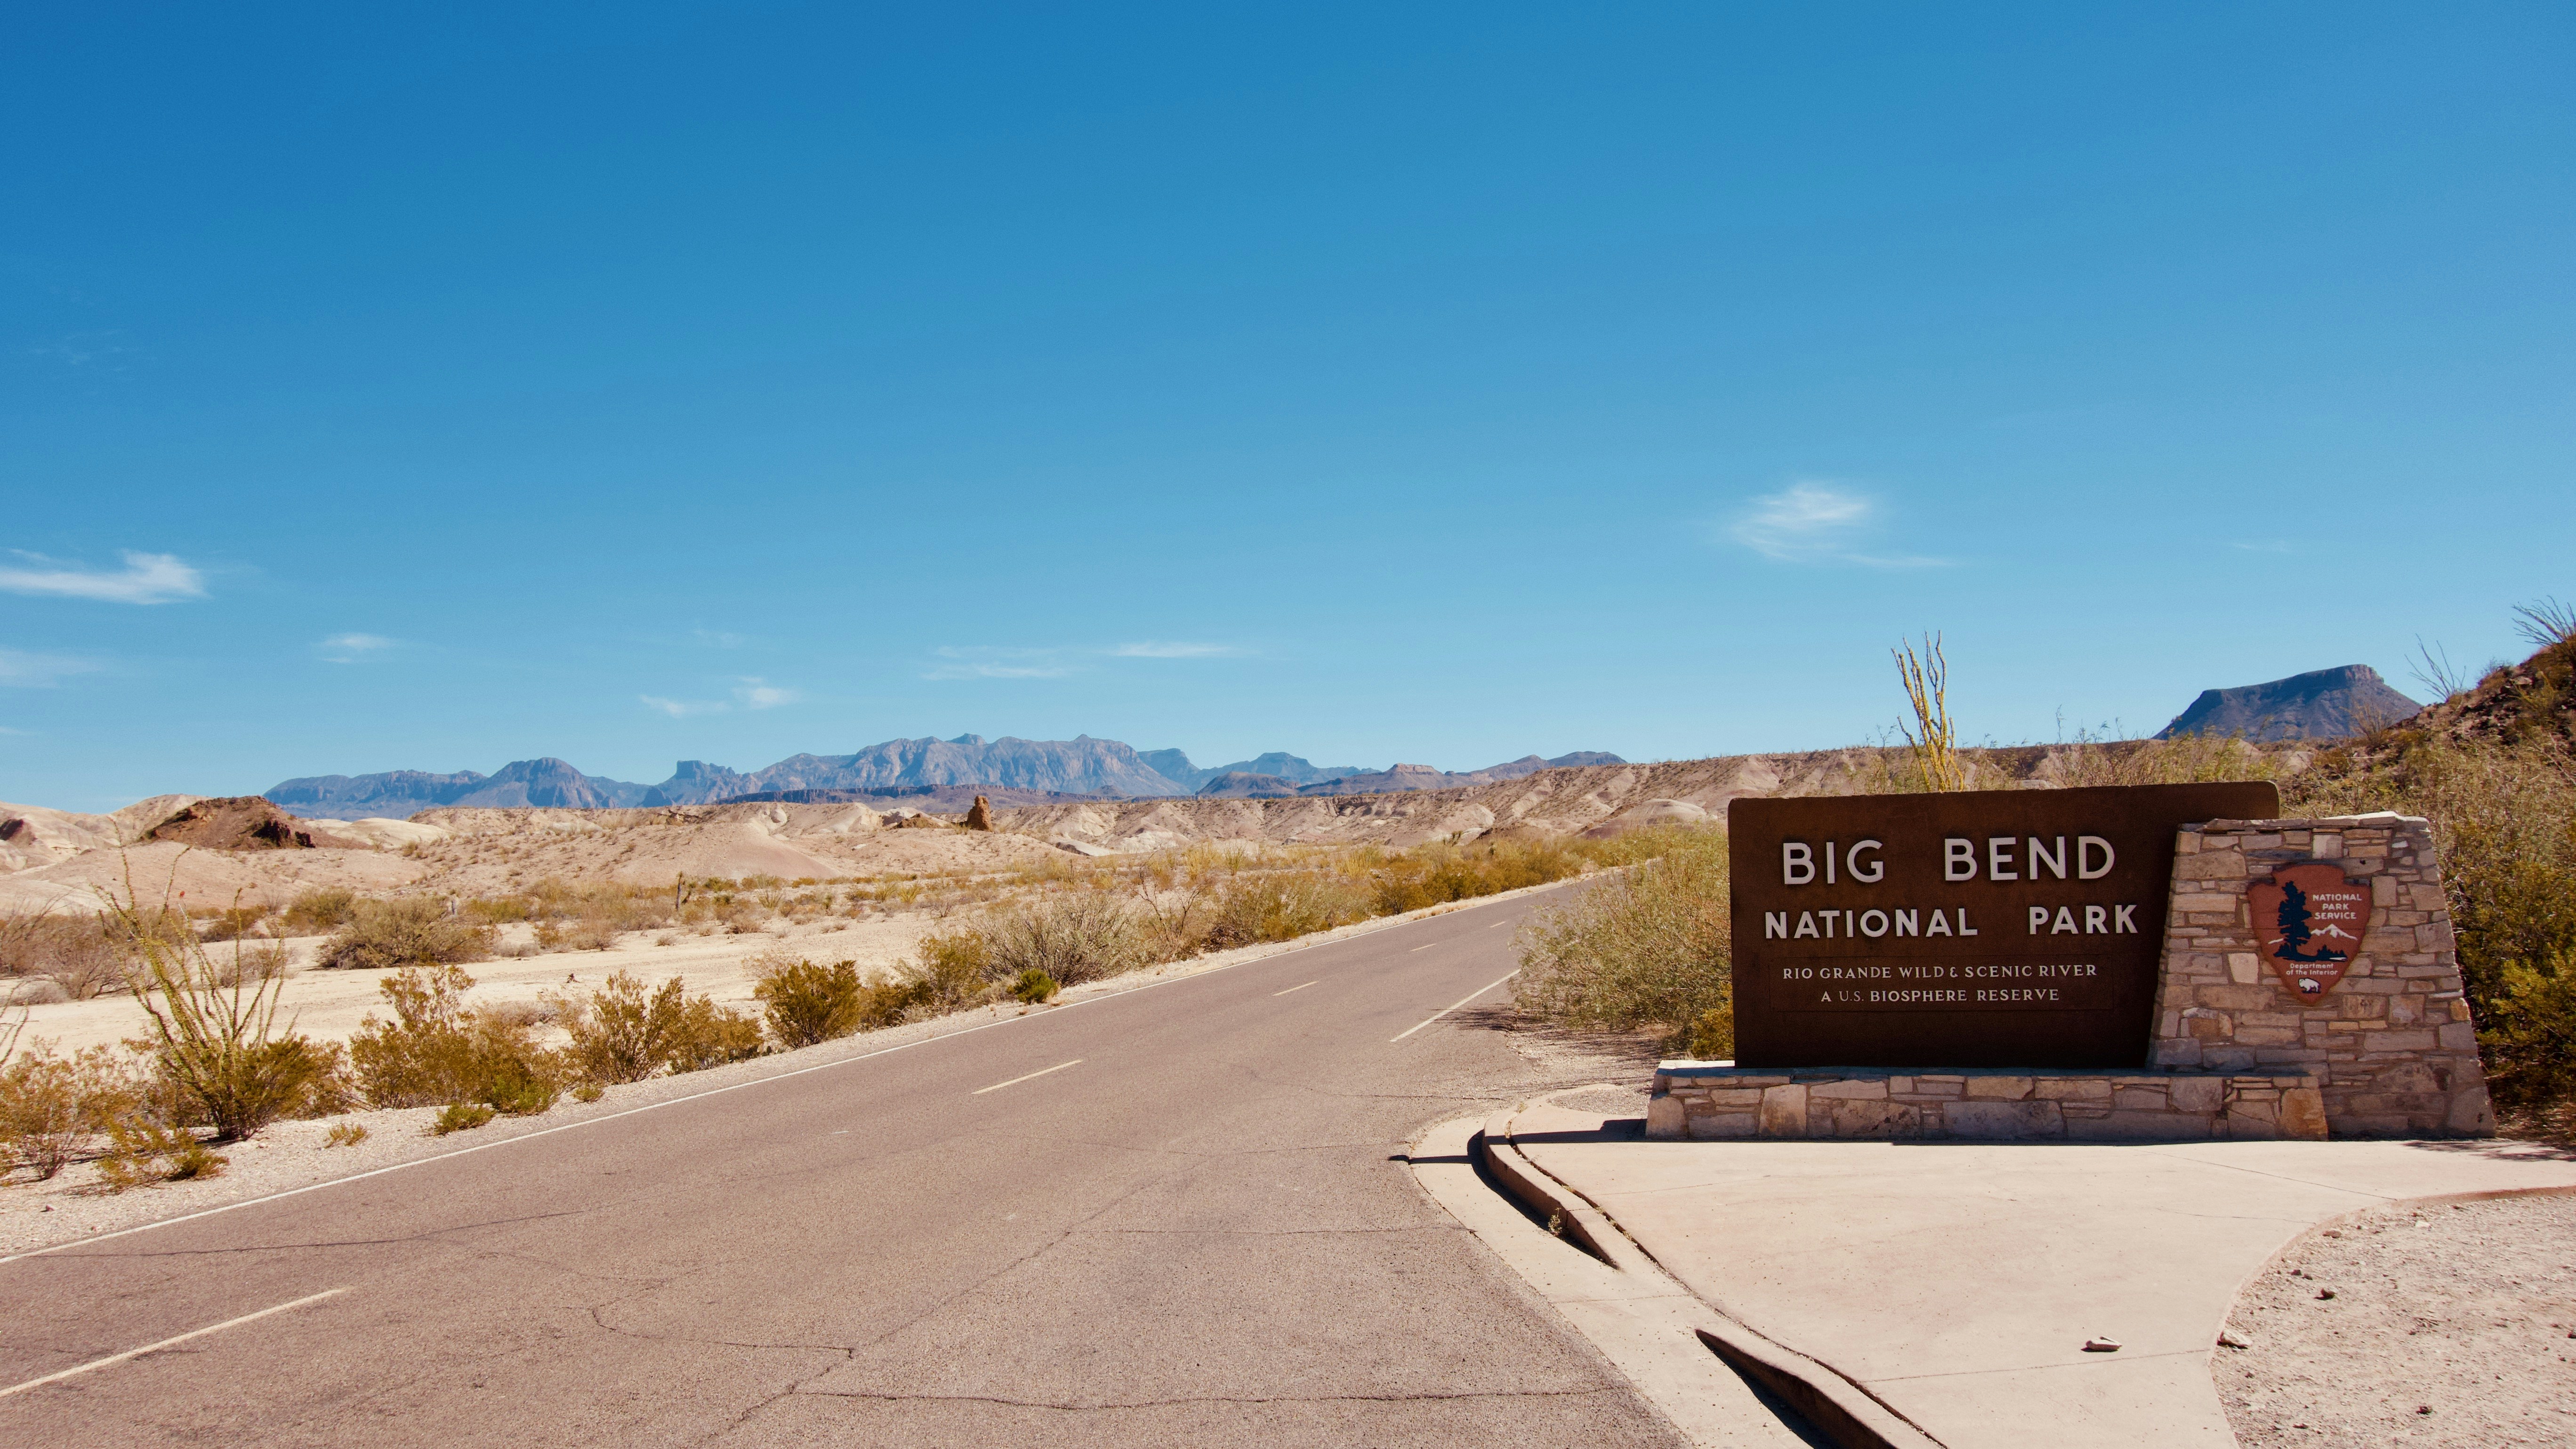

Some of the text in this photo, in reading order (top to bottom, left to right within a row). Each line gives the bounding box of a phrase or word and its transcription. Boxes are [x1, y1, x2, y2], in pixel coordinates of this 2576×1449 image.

[1783, 836, 2115, 885] BIG BEND
[1765, 905, 2138, 939] NATIONAL PARK
[2314, 912, 2357, 920] SERVICE
[1783, 964, 2096, 979] RIO GRANDE WILD & SCENIC RIVER
[1821, 989, 2059, 1002] A U.S. BIOSPHERE RESERVE
